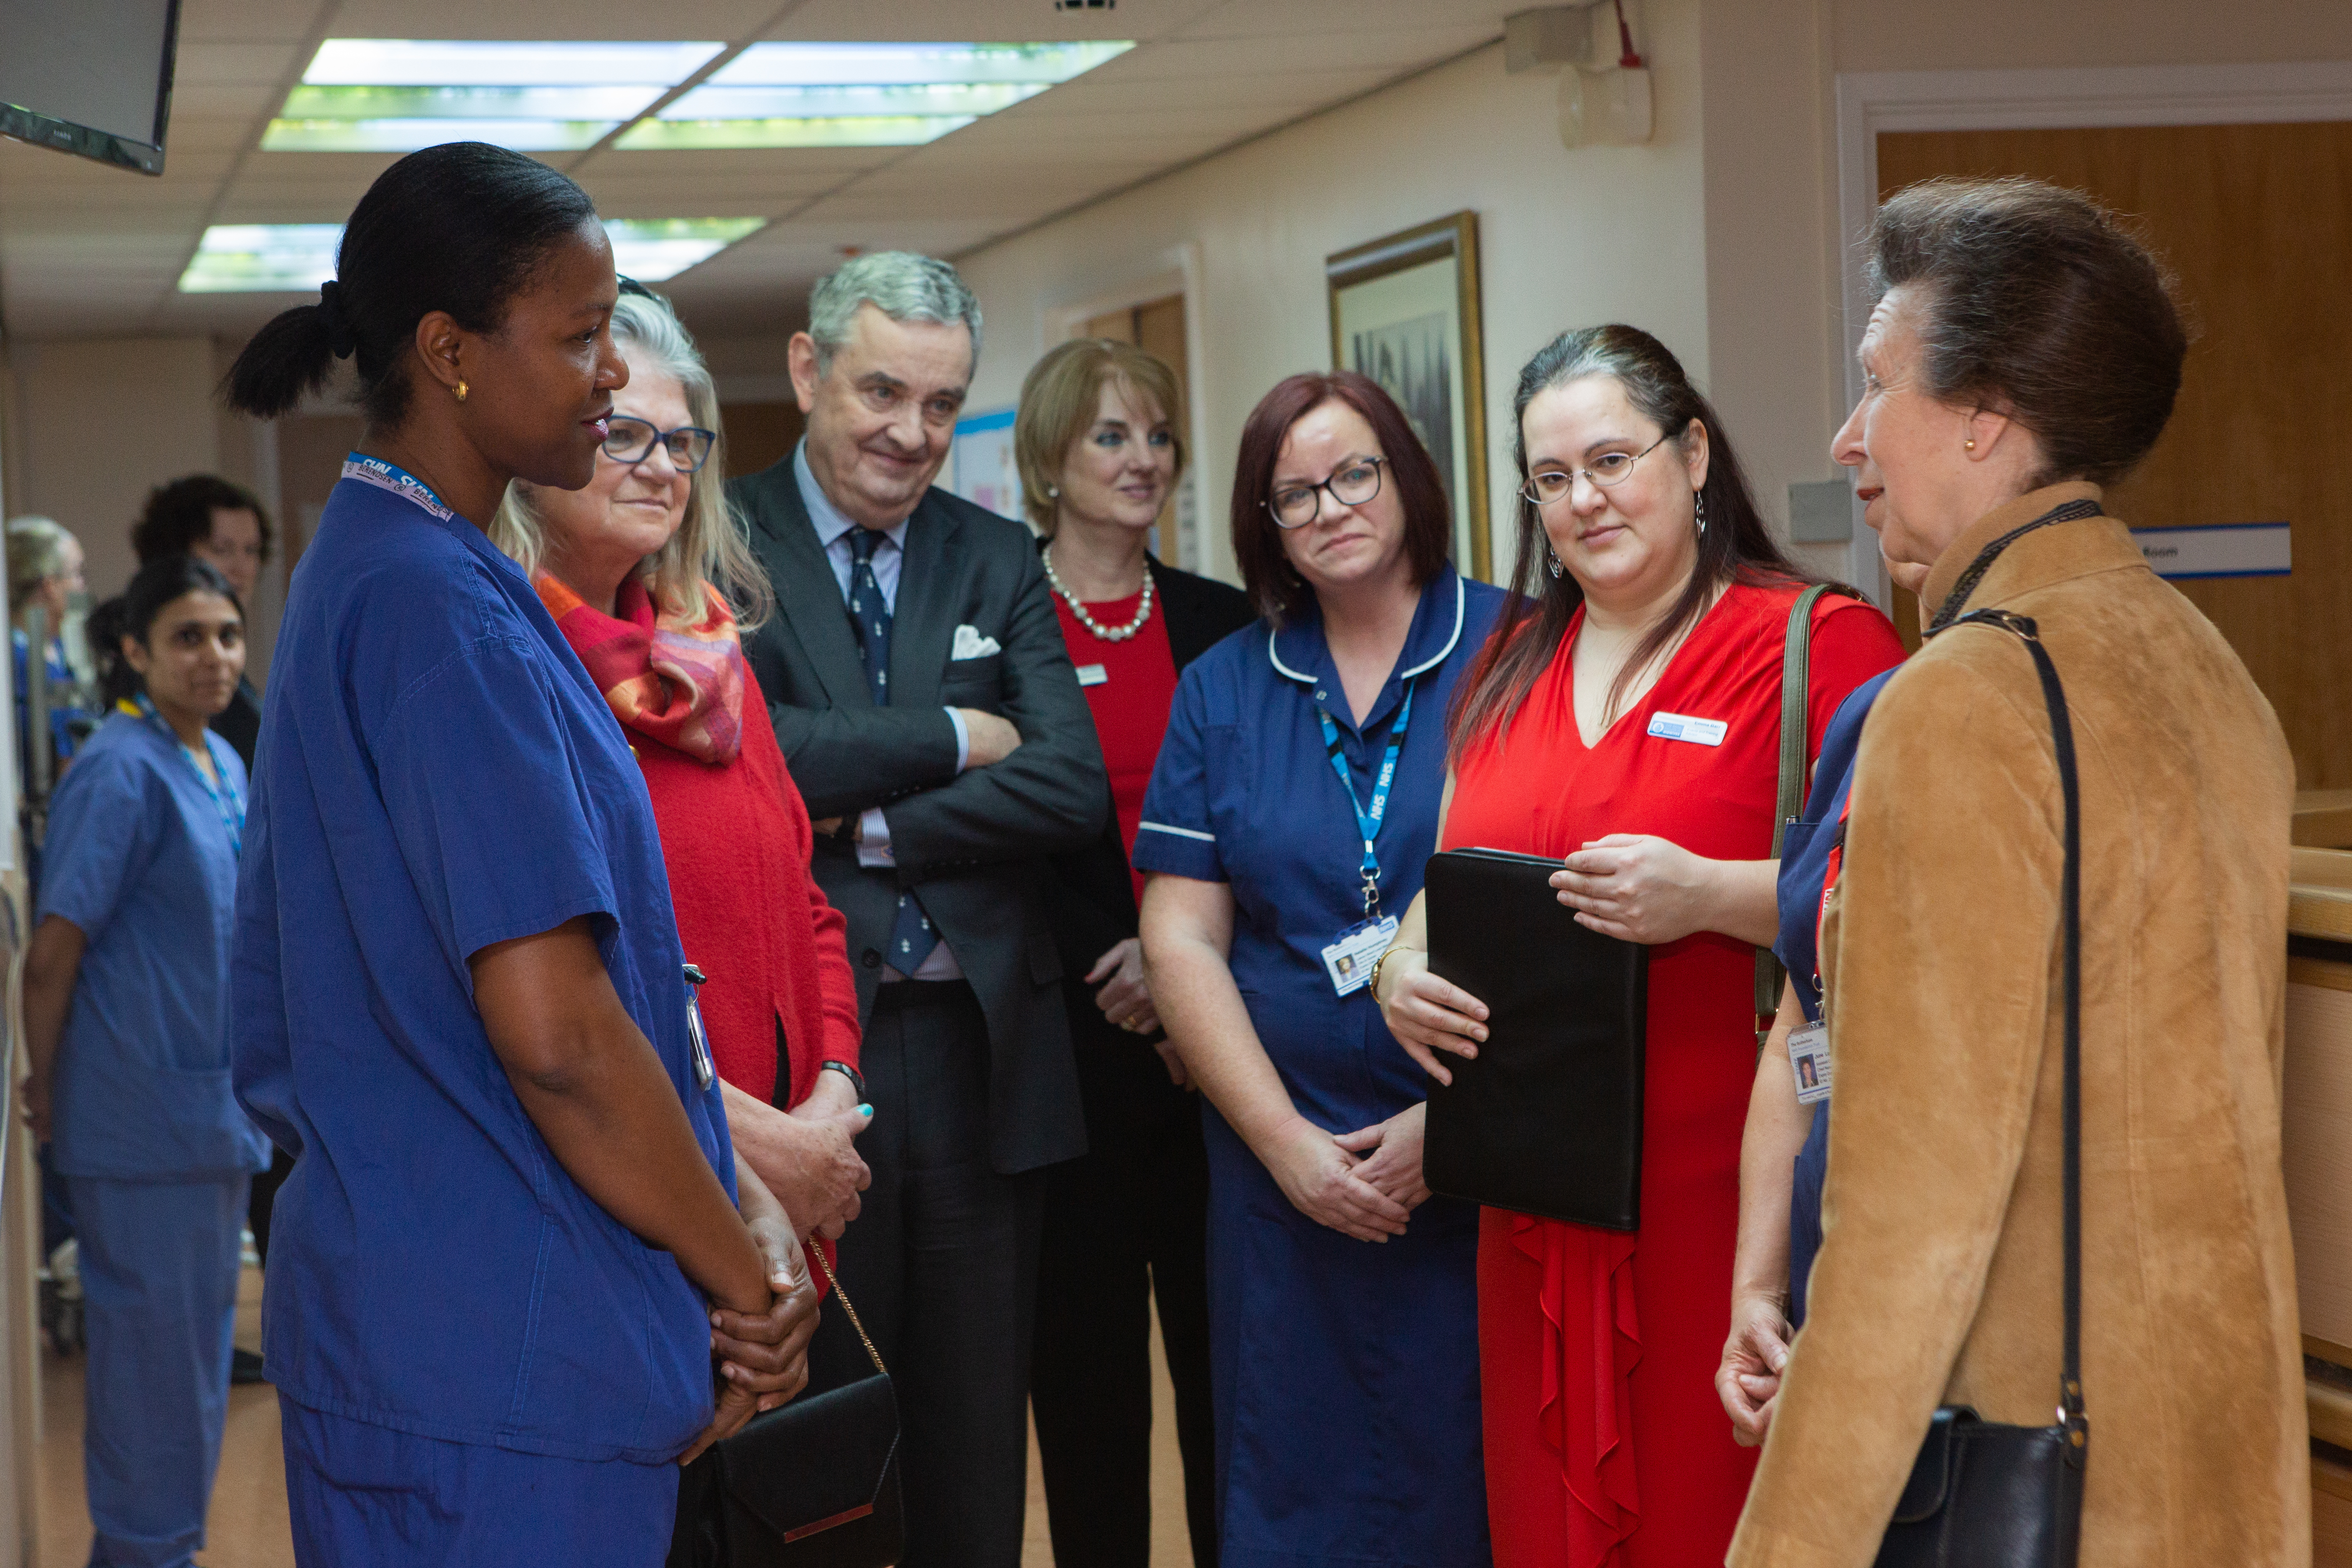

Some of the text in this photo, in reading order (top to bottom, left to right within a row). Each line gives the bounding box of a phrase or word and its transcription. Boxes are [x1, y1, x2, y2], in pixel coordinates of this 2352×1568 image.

[358, 464, 392, 483] BERENDSEN
[1370, 762, 1393, 820] NHS NHS
